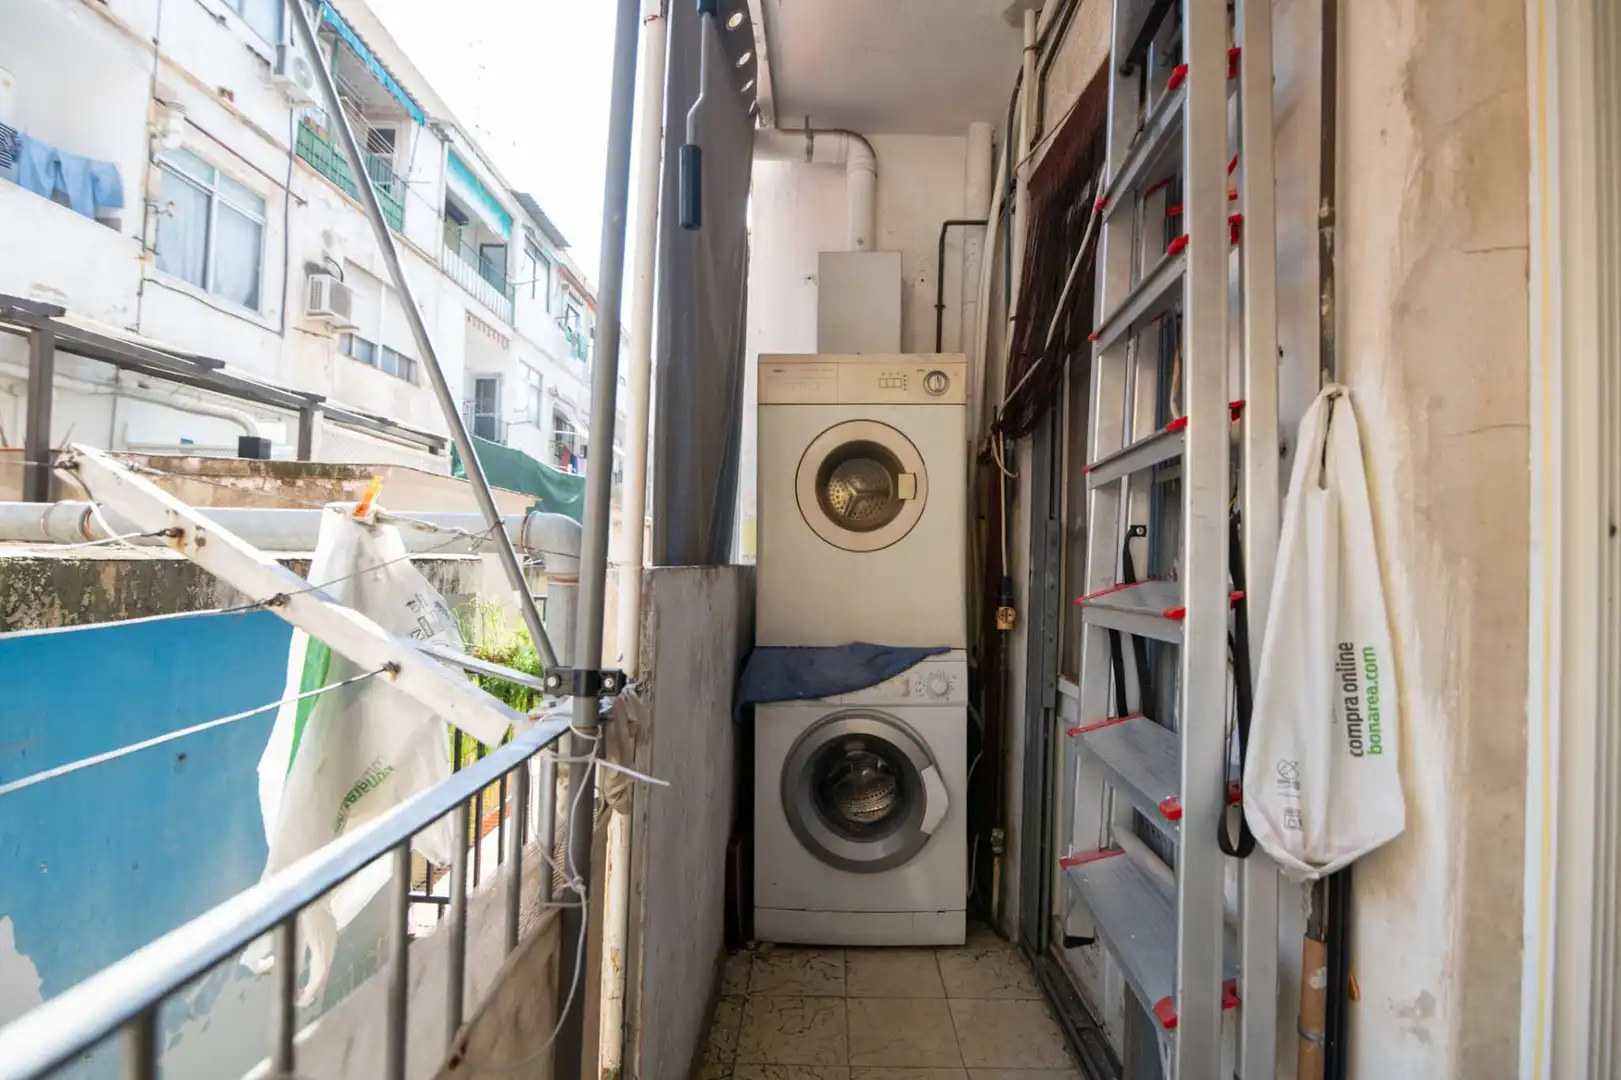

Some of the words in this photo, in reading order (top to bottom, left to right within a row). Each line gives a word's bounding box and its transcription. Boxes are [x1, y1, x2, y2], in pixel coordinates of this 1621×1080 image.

[1335, 642, 1358, 693] online
[1344, 696, 1364, 757] compra
[1362, 646, 1382, 755] bonarea.com
